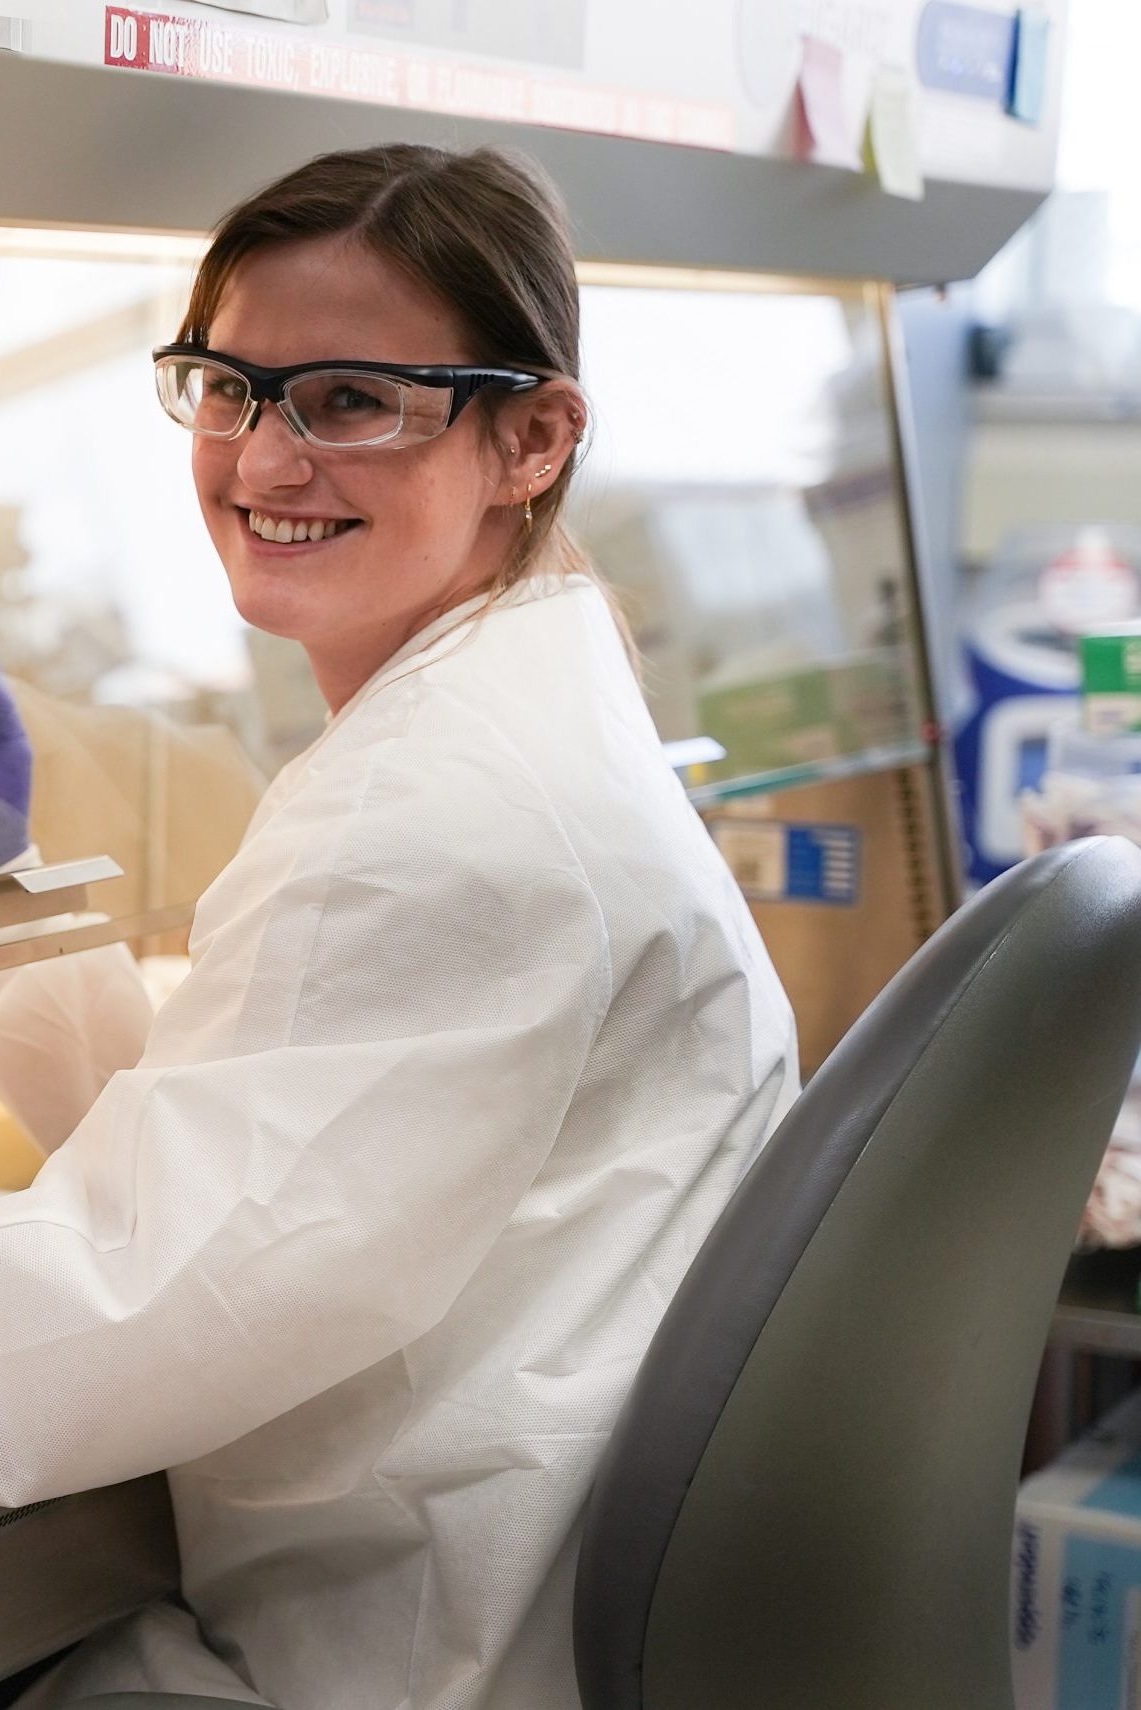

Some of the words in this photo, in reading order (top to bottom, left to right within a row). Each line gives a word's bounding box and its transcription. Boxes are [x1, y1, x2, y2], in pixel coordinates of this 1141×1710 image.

[110, 14, 137, 61] DO
[149, 19, 185, 67] NOT
[199, 27, 233, 74] USE
[245, 34, 299, 91] TOXIC,
